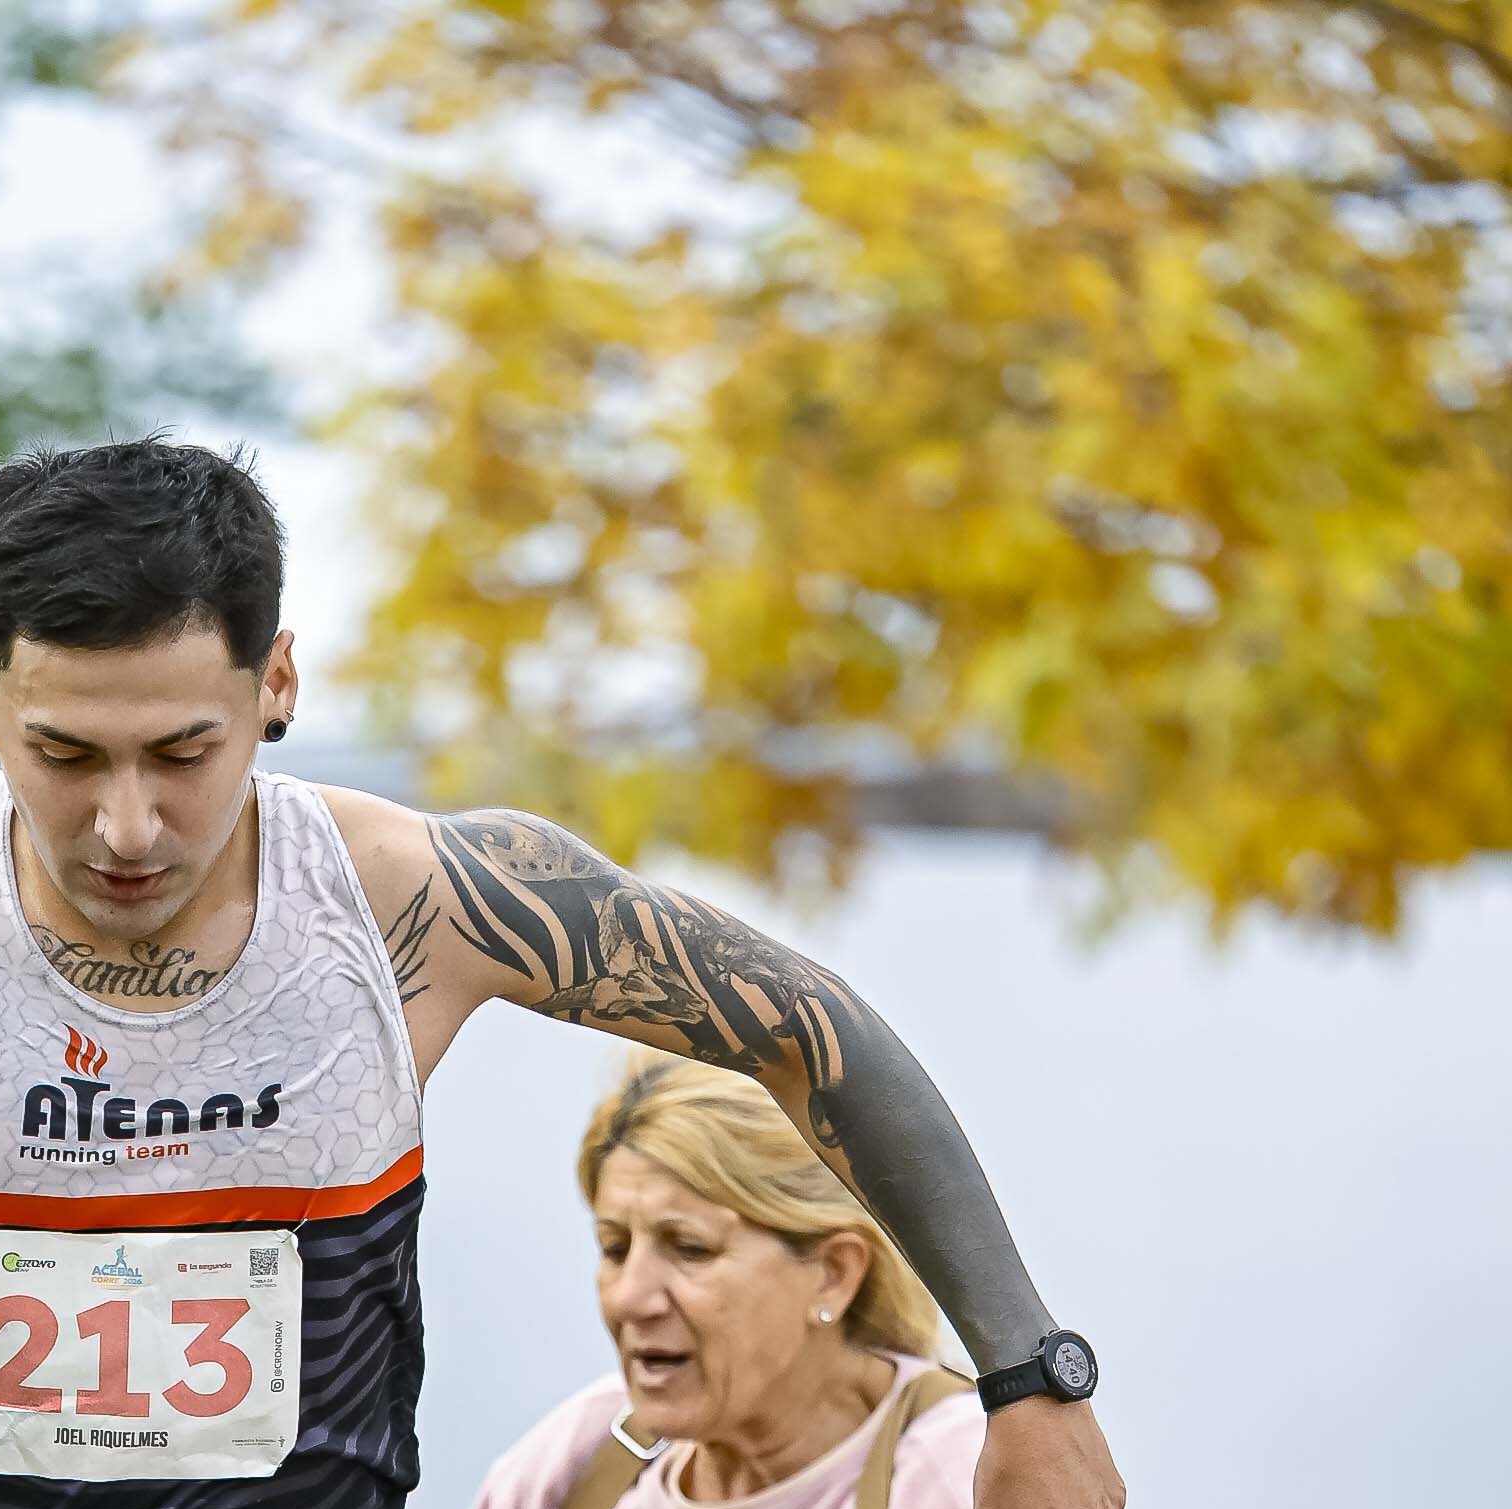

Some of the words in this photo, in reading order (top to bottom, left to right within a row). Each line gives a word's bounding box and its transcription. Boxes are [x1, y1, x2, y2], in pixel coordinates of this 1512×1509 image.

[19, 1143, 117, 1166] running
[126, 1140, 190, 1161] team
[91, 1264, 143, 1278] ACEBAL
[199, 1262, 232, 1271] segunda
[273, 1320, 284, 1377] @CRONORAV
[1060, 1346, 1080, 1384] 14:40
[53, 1427, 87, 1446] JOEL
[90, 1429, 169, 1449] RIQUELMES
